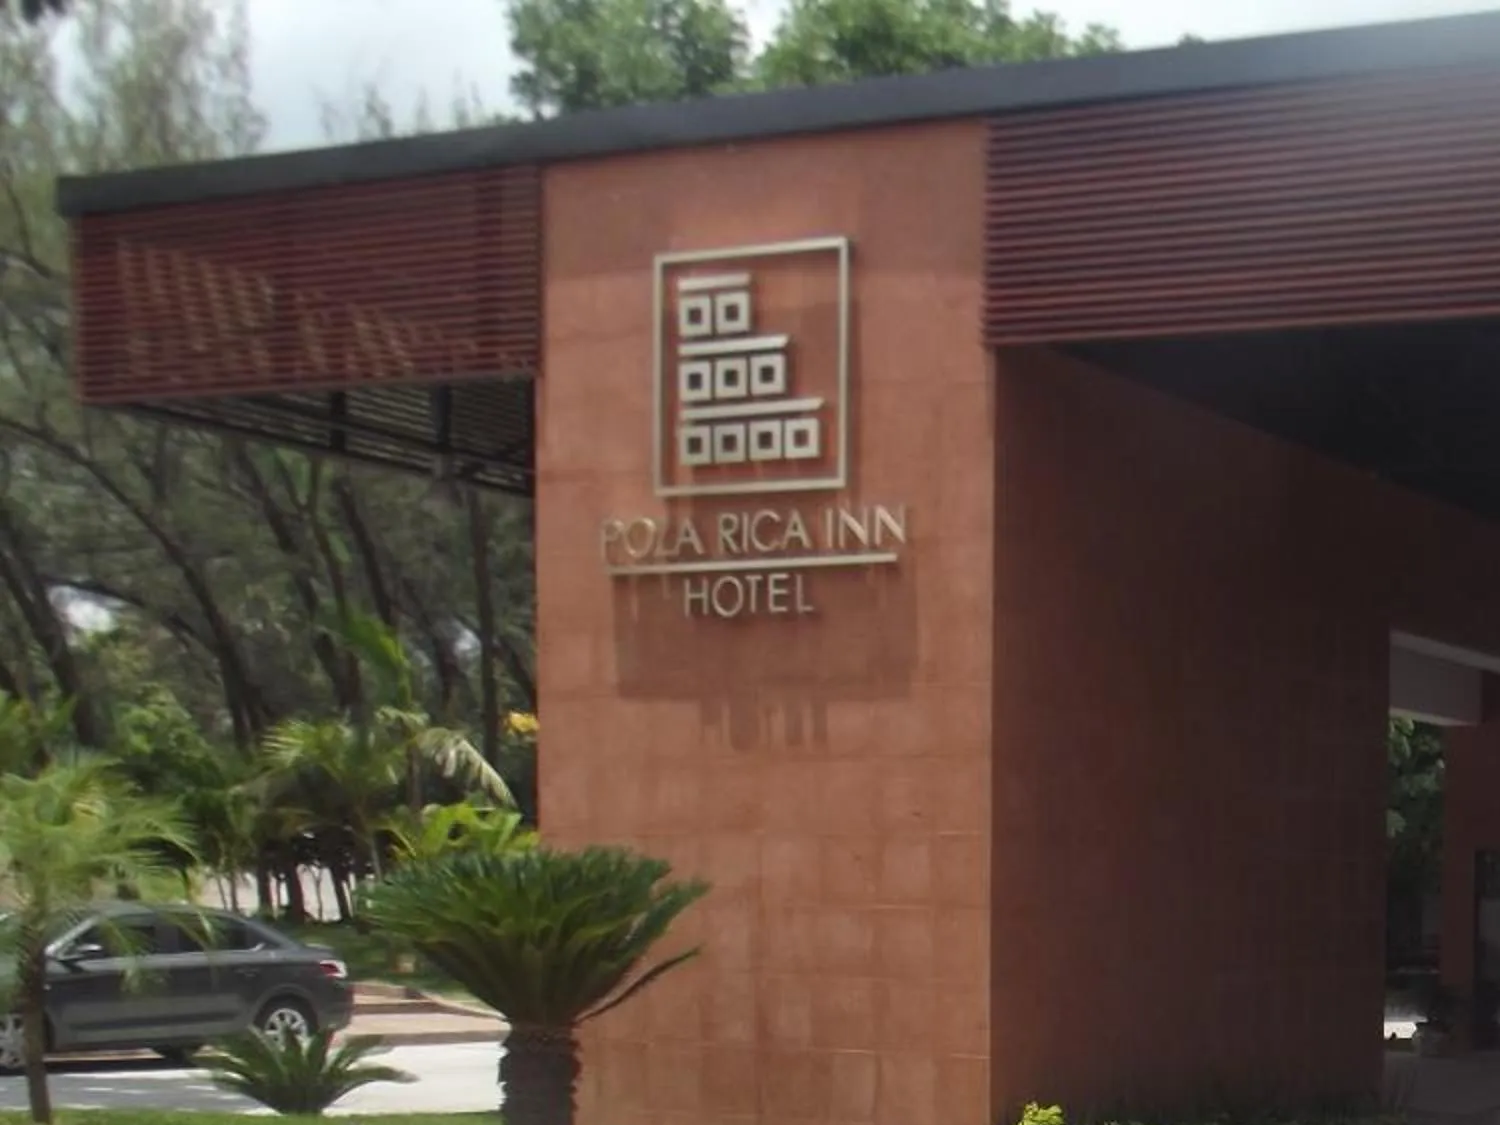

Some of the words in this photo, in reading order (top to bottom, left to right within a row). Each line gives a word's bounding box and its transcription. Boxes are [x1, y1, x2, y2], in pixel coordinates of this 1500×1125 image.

[717, 508, 812, 554] RICA
[823, 501, 907, 549] INN
[683, 572, 815, 618] HOTEL
